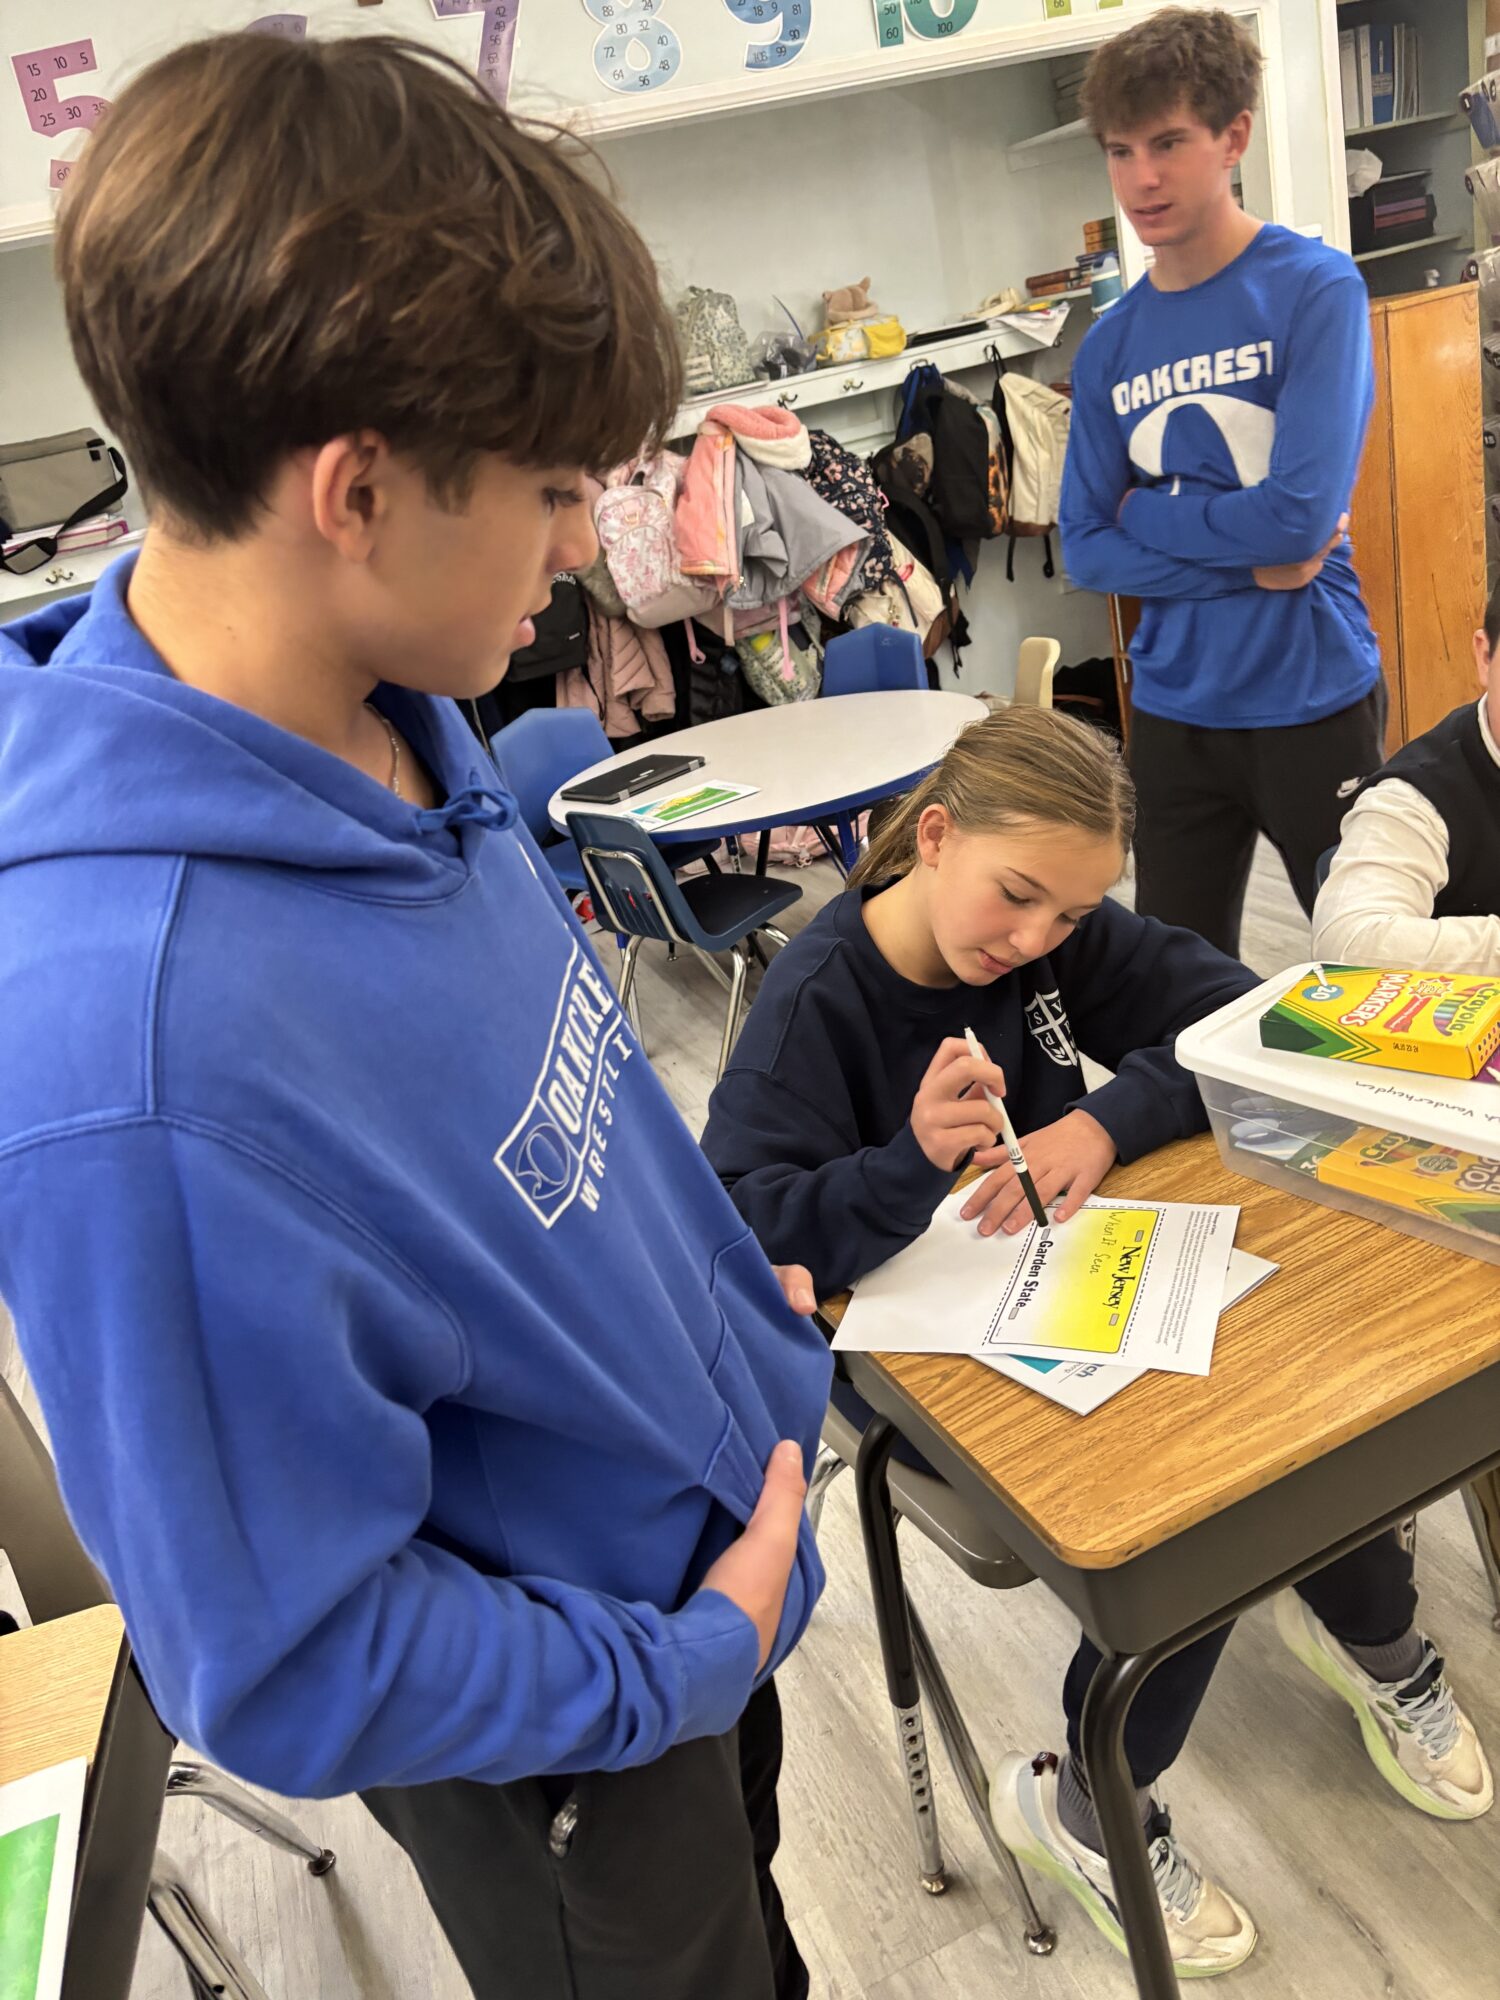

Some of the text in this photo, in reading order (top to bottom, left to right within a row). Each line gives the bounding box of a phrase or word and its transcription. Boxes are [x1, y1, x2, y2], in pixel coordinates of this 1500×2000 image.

[495, 5, 507, 17] 42
[602, 5, 614, 17] 88
[753, 5, 764, 16] 18
[771, 1, 778, 13] 9
[792, 4, 801, 16] 81
[883, 3, 897, 16] 50
[616, 22, 628, 35] 80
[638, 19, 650, 31] 32
[937, 21, 953, 33] 100
[789, 28, 800, 40] 90
[886, 26, 899, 39] 60
[657, 34, 669, 46] 40
[603, 46, 616, 59] 72
[775, 45, 787, 57] 99
[26, 52, 89, 77] 15 10 5
[658, 59, 670, 71] 48
[638, 75, 650, 87] 56
[31, 87, 47, 102] 20
[40, 112, 56, 127] 25
[65, 105, 82, 120] 30
[1111, 340, 1272, 415] OAKCREST
[1310, 985, 1338, 1000] 20
[1339, 972, 1412, 1027] MARKERS
[1449, 987, 1500, 1032] Crayola
[1103, 1211, 1126, 1236] When
[1015, 1240, 1054, 1308] Garden State
[1102, 1245, 1143, 1310] New Jersey
